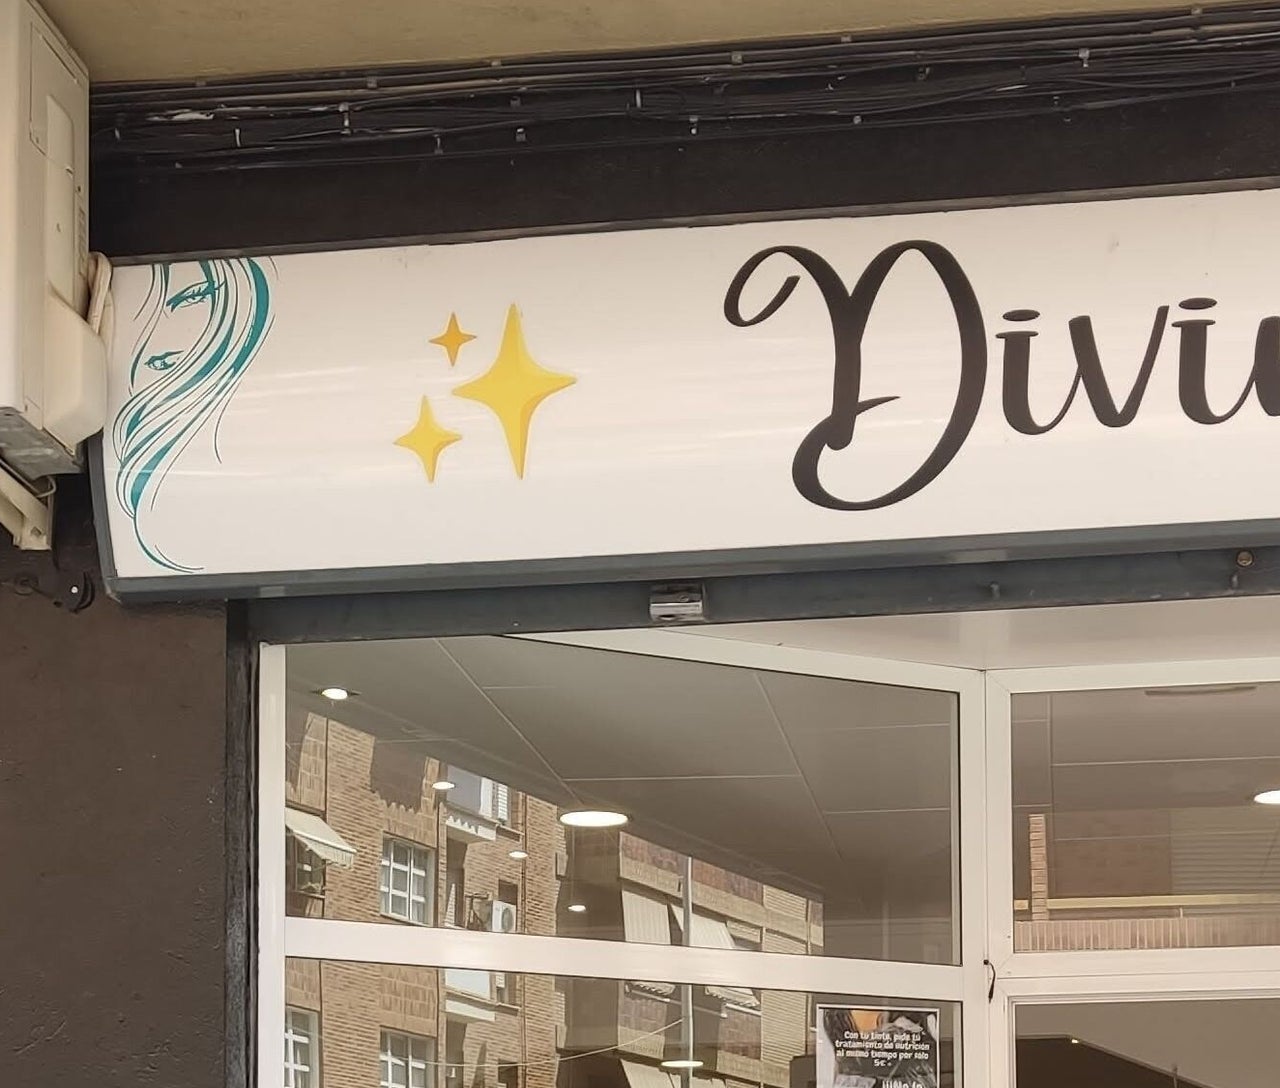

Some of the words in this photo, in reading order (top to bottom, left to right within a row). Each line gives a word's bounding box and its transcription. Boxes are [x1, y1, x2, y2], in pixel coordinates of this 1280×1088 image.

[835, 1040, 882, 1049] tratamiento
[884, 1041, 893, 1049] de
[836, 1049, 844, 1057] al
[846, 1050, 869, 1058] mismo
[871, 1050, 897, 1060] tiempo
[899, 1052, 913, 1061] por
